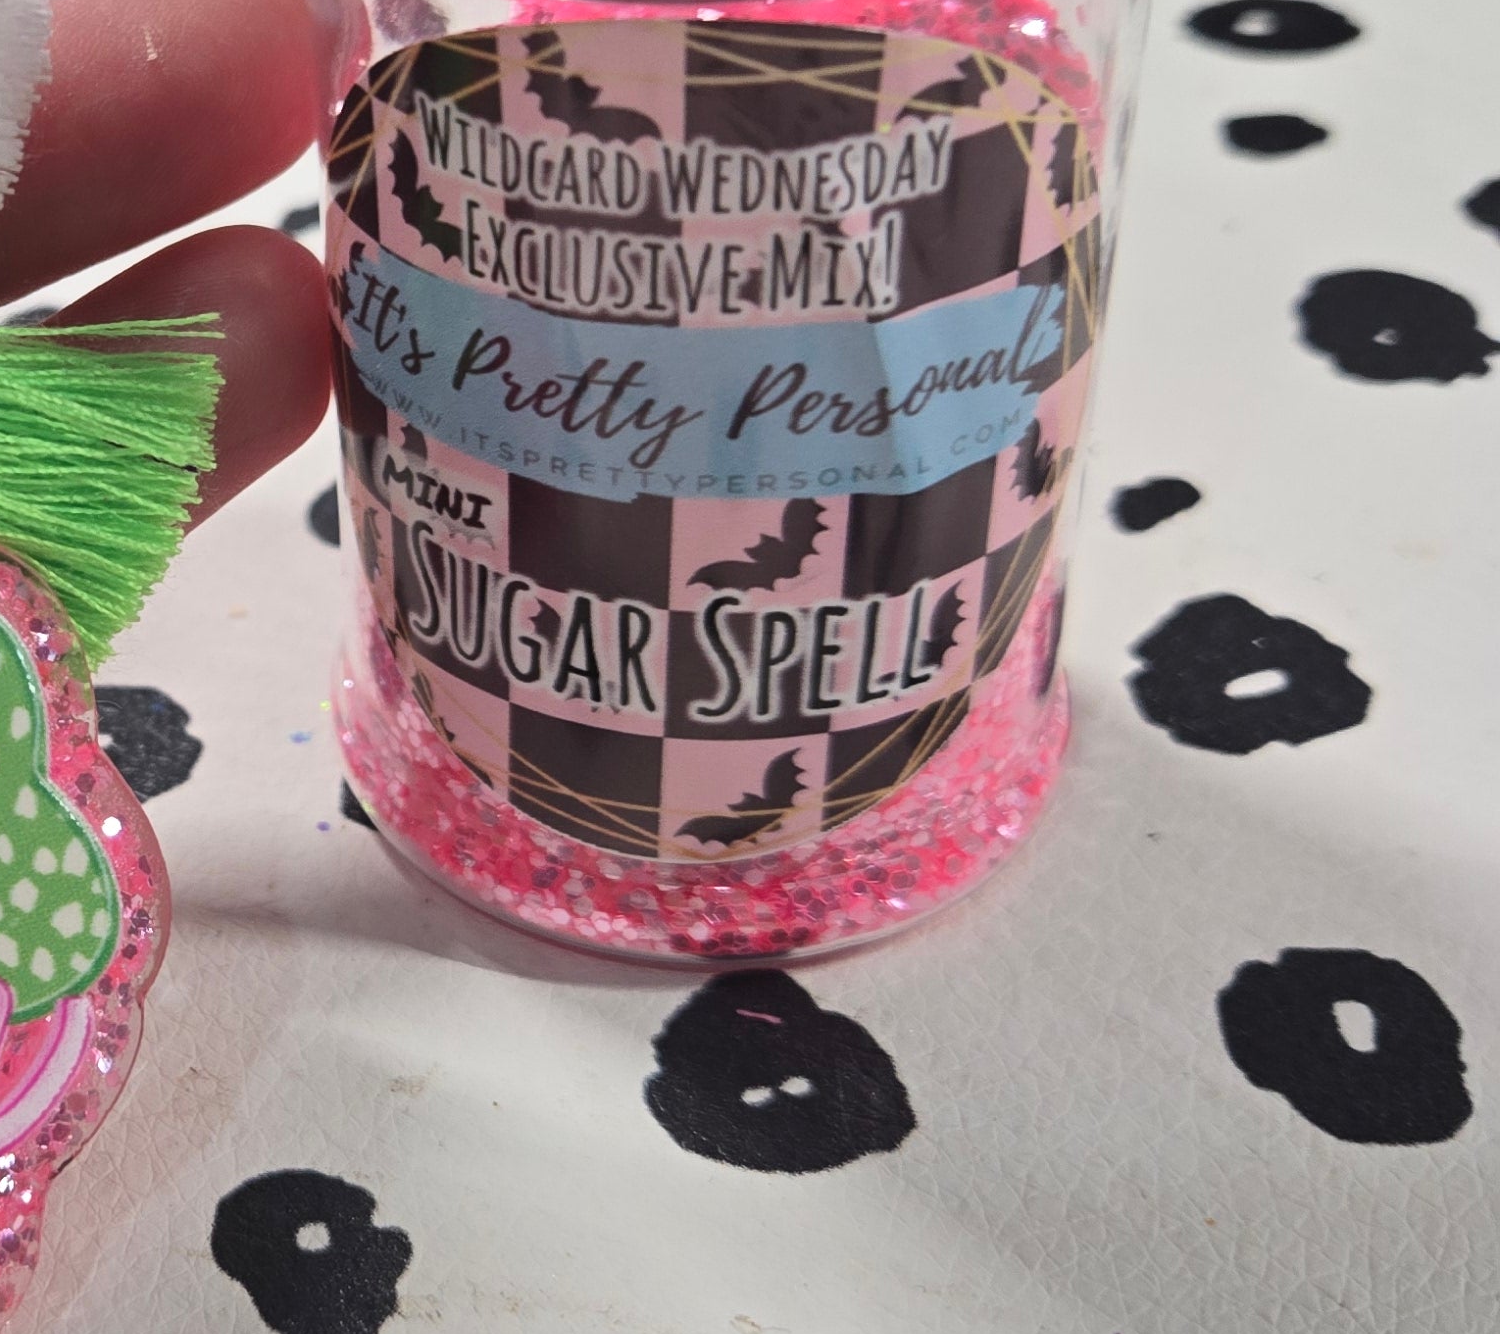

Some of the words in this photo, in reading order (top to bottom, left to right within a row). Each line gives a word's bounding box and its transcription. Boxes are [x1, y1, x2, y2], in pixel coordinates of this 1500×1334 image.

[418, 93, 642, 211] WILDCARD
[662, 122, 952, 215] WEDNESDAY
[465, 199, 744, 315] EXCLUSIVE
[768, 216, 896, 312] MIX!
[352, 271, 436, 376] It's
[452, 327, 705, 469] Pretty
[725, 281, 1050, 441] Personal
[382, 453, 493, 530] MINI
[409, 519, 657, 713] SUGAR
[695, 585, 932, 718] SPELL
